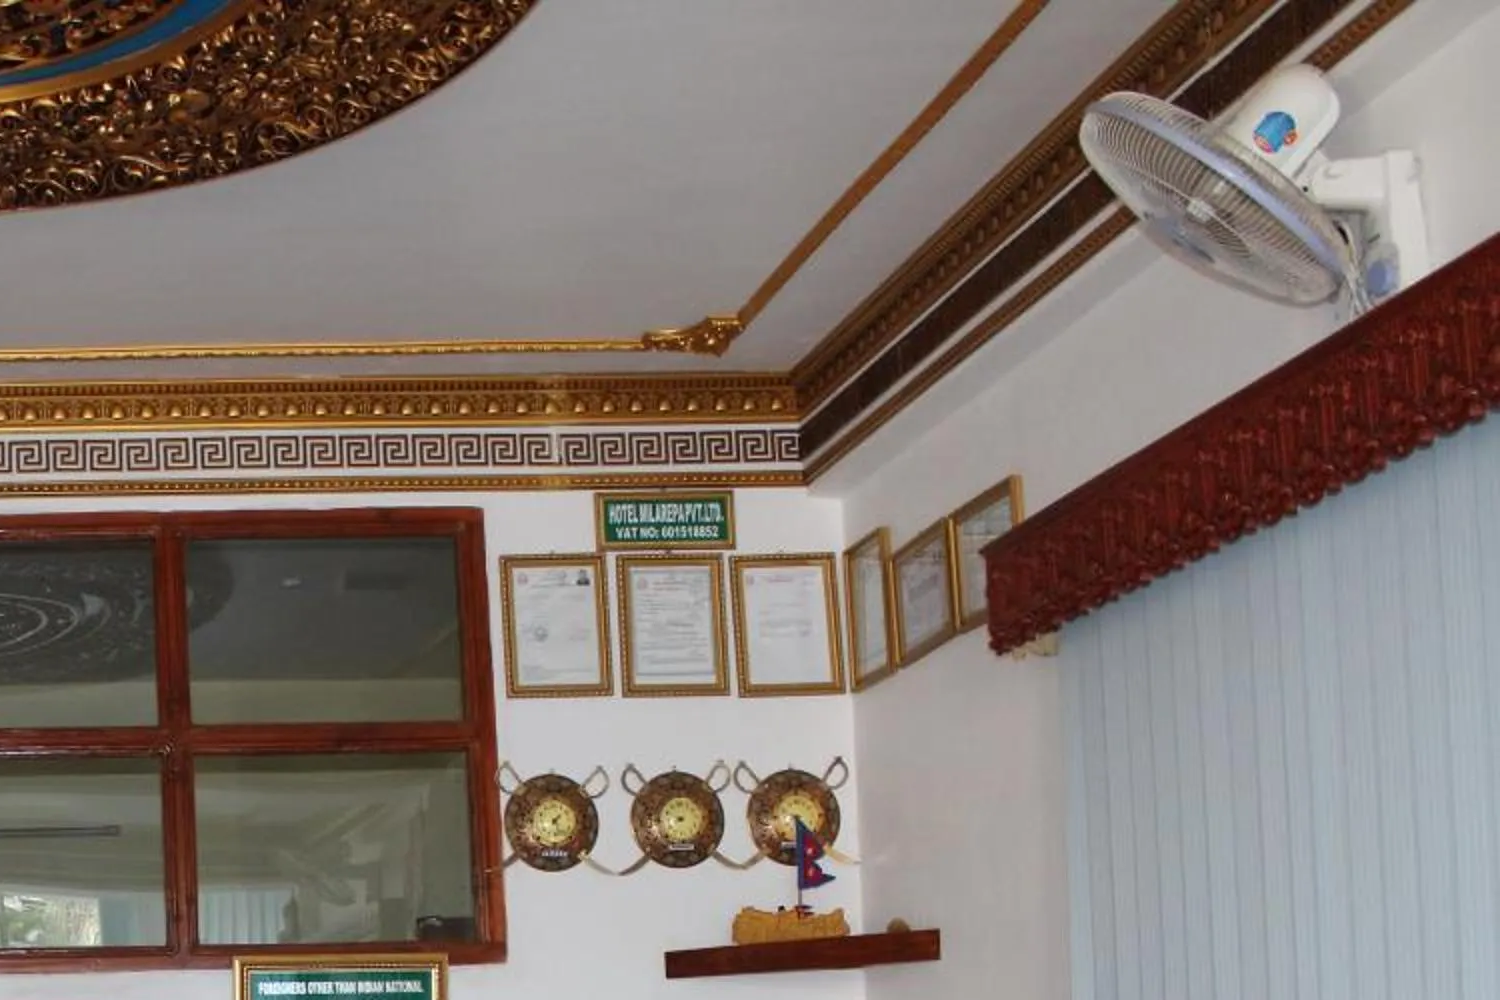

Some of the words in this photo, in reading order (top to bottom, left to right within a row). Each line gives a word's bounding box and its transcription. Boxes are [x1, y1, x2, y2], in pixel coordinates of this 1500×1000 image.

[609, 503, 637, 524] HOTEL
[615, 527, 637, 539] VAT
[259, 981, 306, 995] FOREIGNERS
[308, 981, 333, 995] OTHER
[335, 981, 356, 994] THAN
